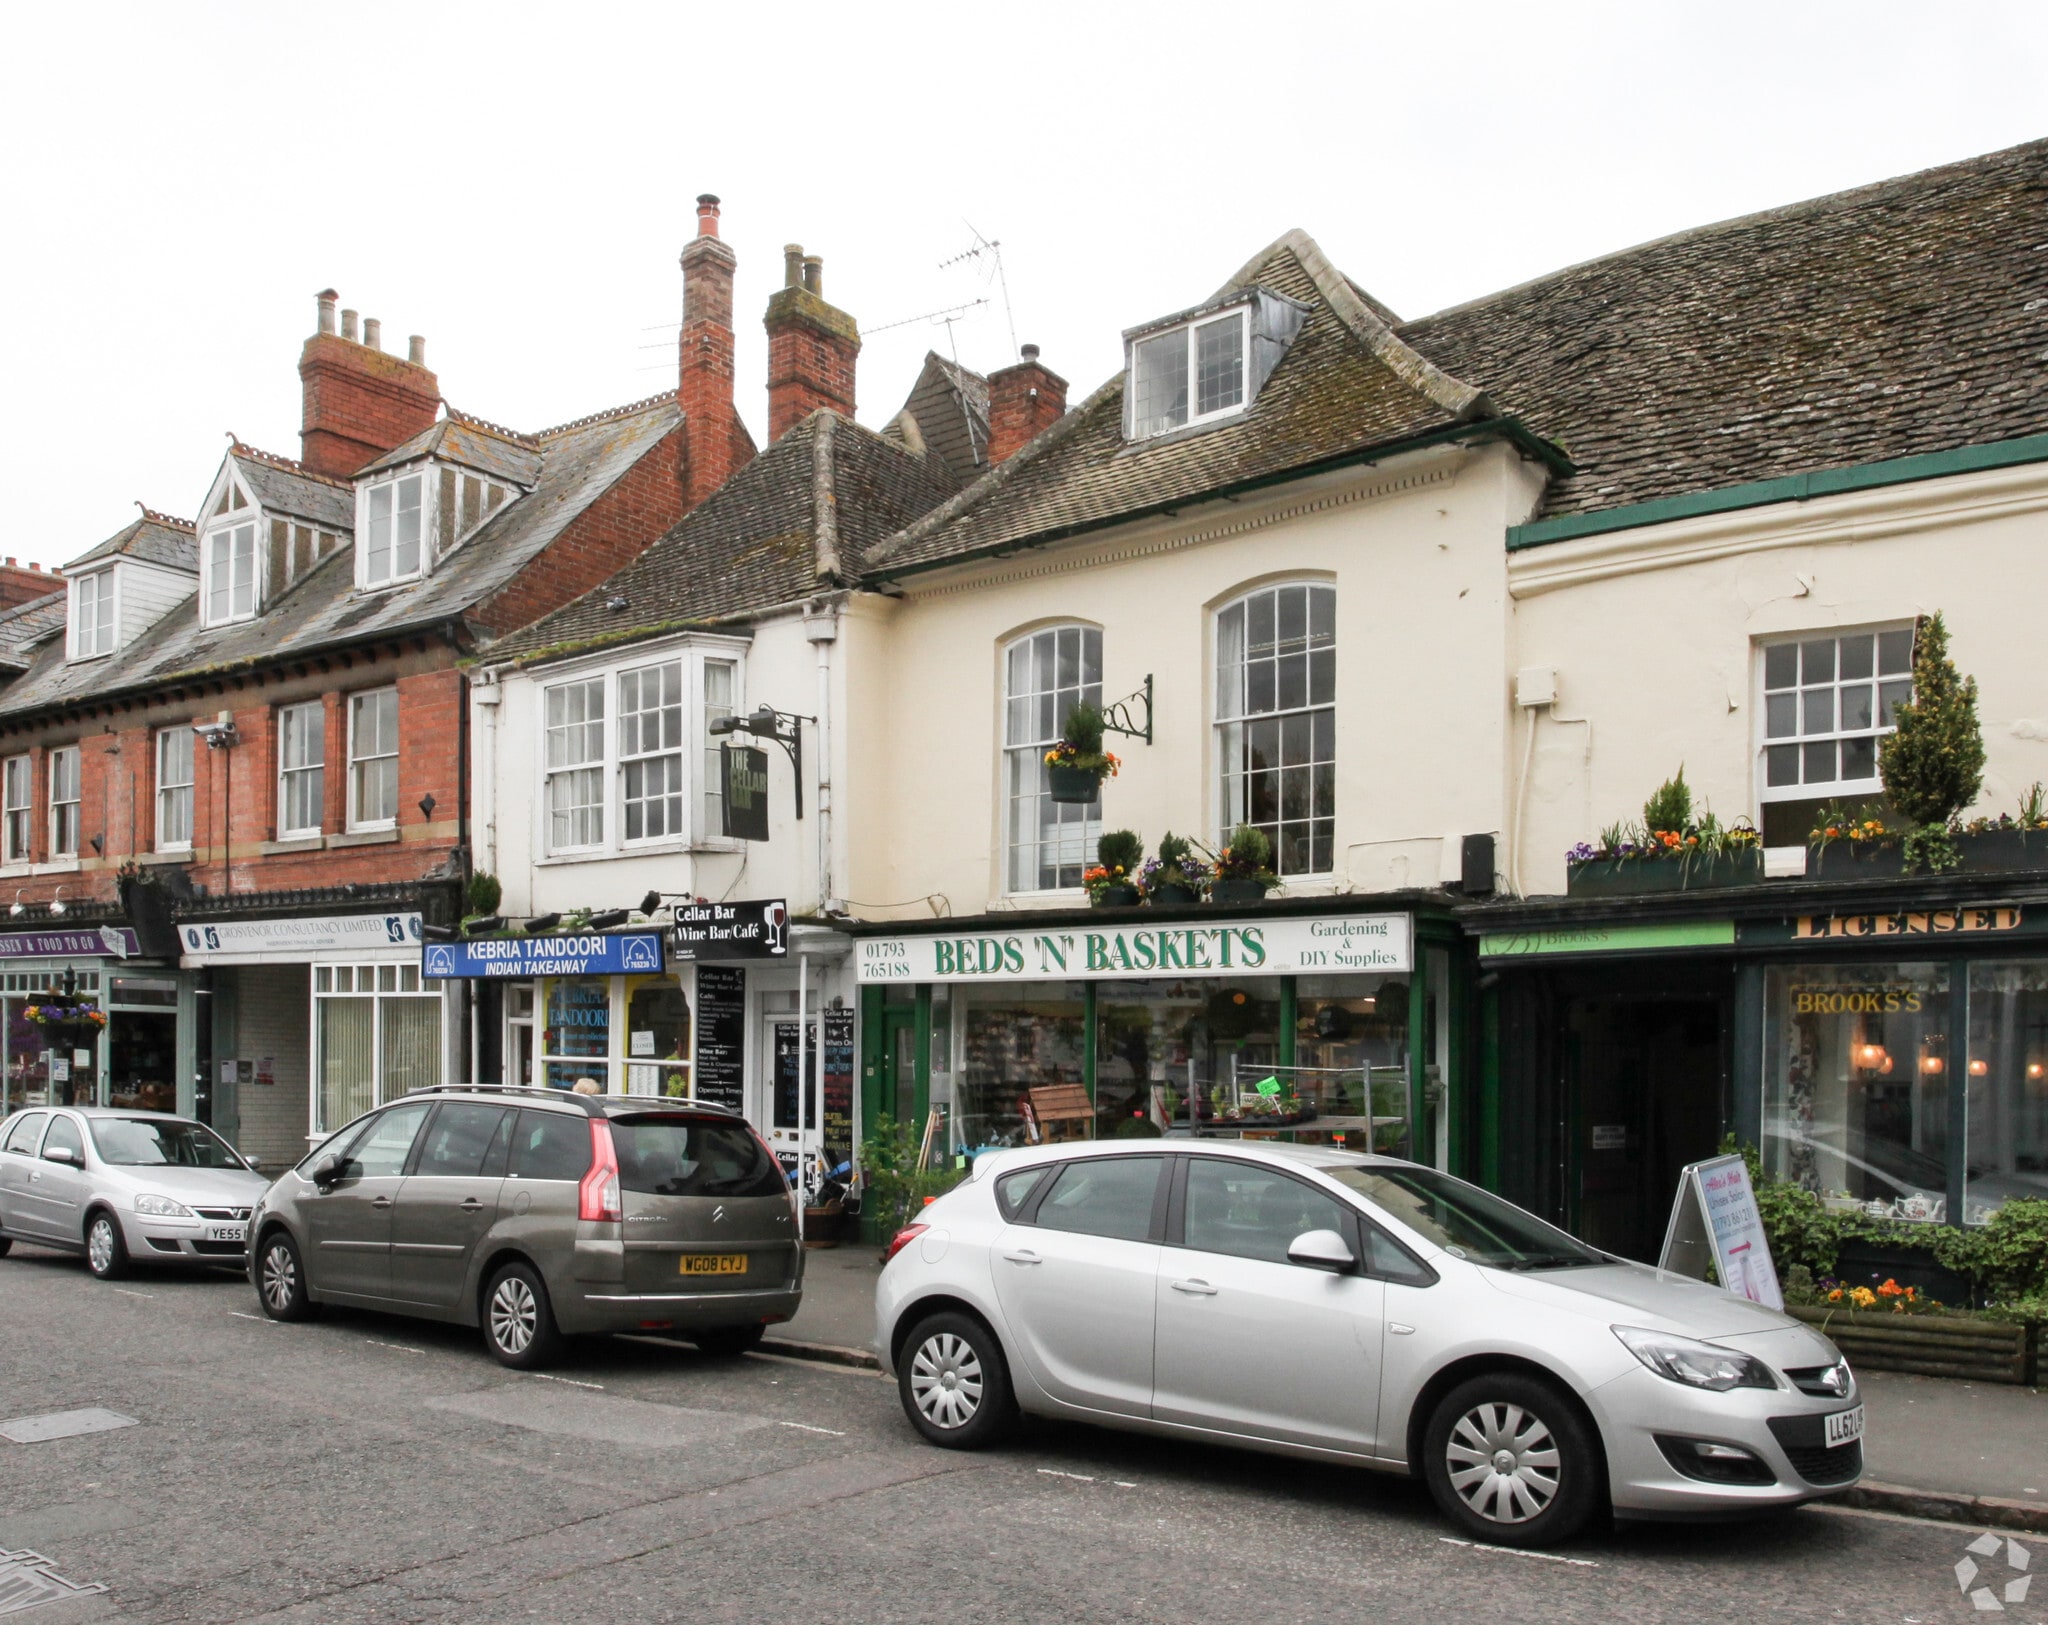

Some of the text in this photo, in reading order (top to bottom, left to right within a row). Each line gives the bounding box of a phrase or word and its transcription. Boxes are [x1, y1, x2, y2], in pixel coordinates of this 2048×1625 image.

[730, 749, 749, 771] THE
[730, 768, 767, 793] CELLAR
[676, 905, 736, 922] Cellar Bar
[218, 919, 382, 939] GROSVENOR CONSULTANCY LIMITED
[677, 923, 760, 940] Wine Bar/Café
[1310, 921, 1388, 938] Gardening
[1791, 908, 2023, 940] LICENSED
[0, 938, 23, 953] SSEN
[26, 938, 35, 952] &
[37, 937, 63, 951] FOOD
[64, 936, 78, 951] TO
[80, 936, 95, 950] GO
[467, 936, 606, 960] KEBRIA TANDOORI
[866, 943, 905, 959] 01793
[933, 936, 1025, 976] BEDS
[1084, 927, 1267, 972] BASKETS
[1342, 938, 1352, 949] &
[635, 952, 645, 960] Tel
[1299, 950, 1330, 966] DIY
[1334, 948, 1397, 967] Supplies
[485, 959, 588, 976] INDIAN TAKEAWAY
[699, 972, 720, 980] Cellar
[863, 961, 910, 978] 765188
[1796, 989, 1922, 1013] BROOKS'S
[549, 1009, 609, 1026] TANDOORI
[698, 1047, 714, 1055] Wine
[843, 1039, 853, 1047] On
[698, 1086, 743, 1096] Opening Times
[776, 1152, 798, 1162] Cellar
[1729, 1189, 1746, 1203] Salon
[212, 1228, 241, 1240] YE55
[685, 1256, 743, 1271] WG08 CYJ
[1829, 1412, 1854, 1442] LL62
